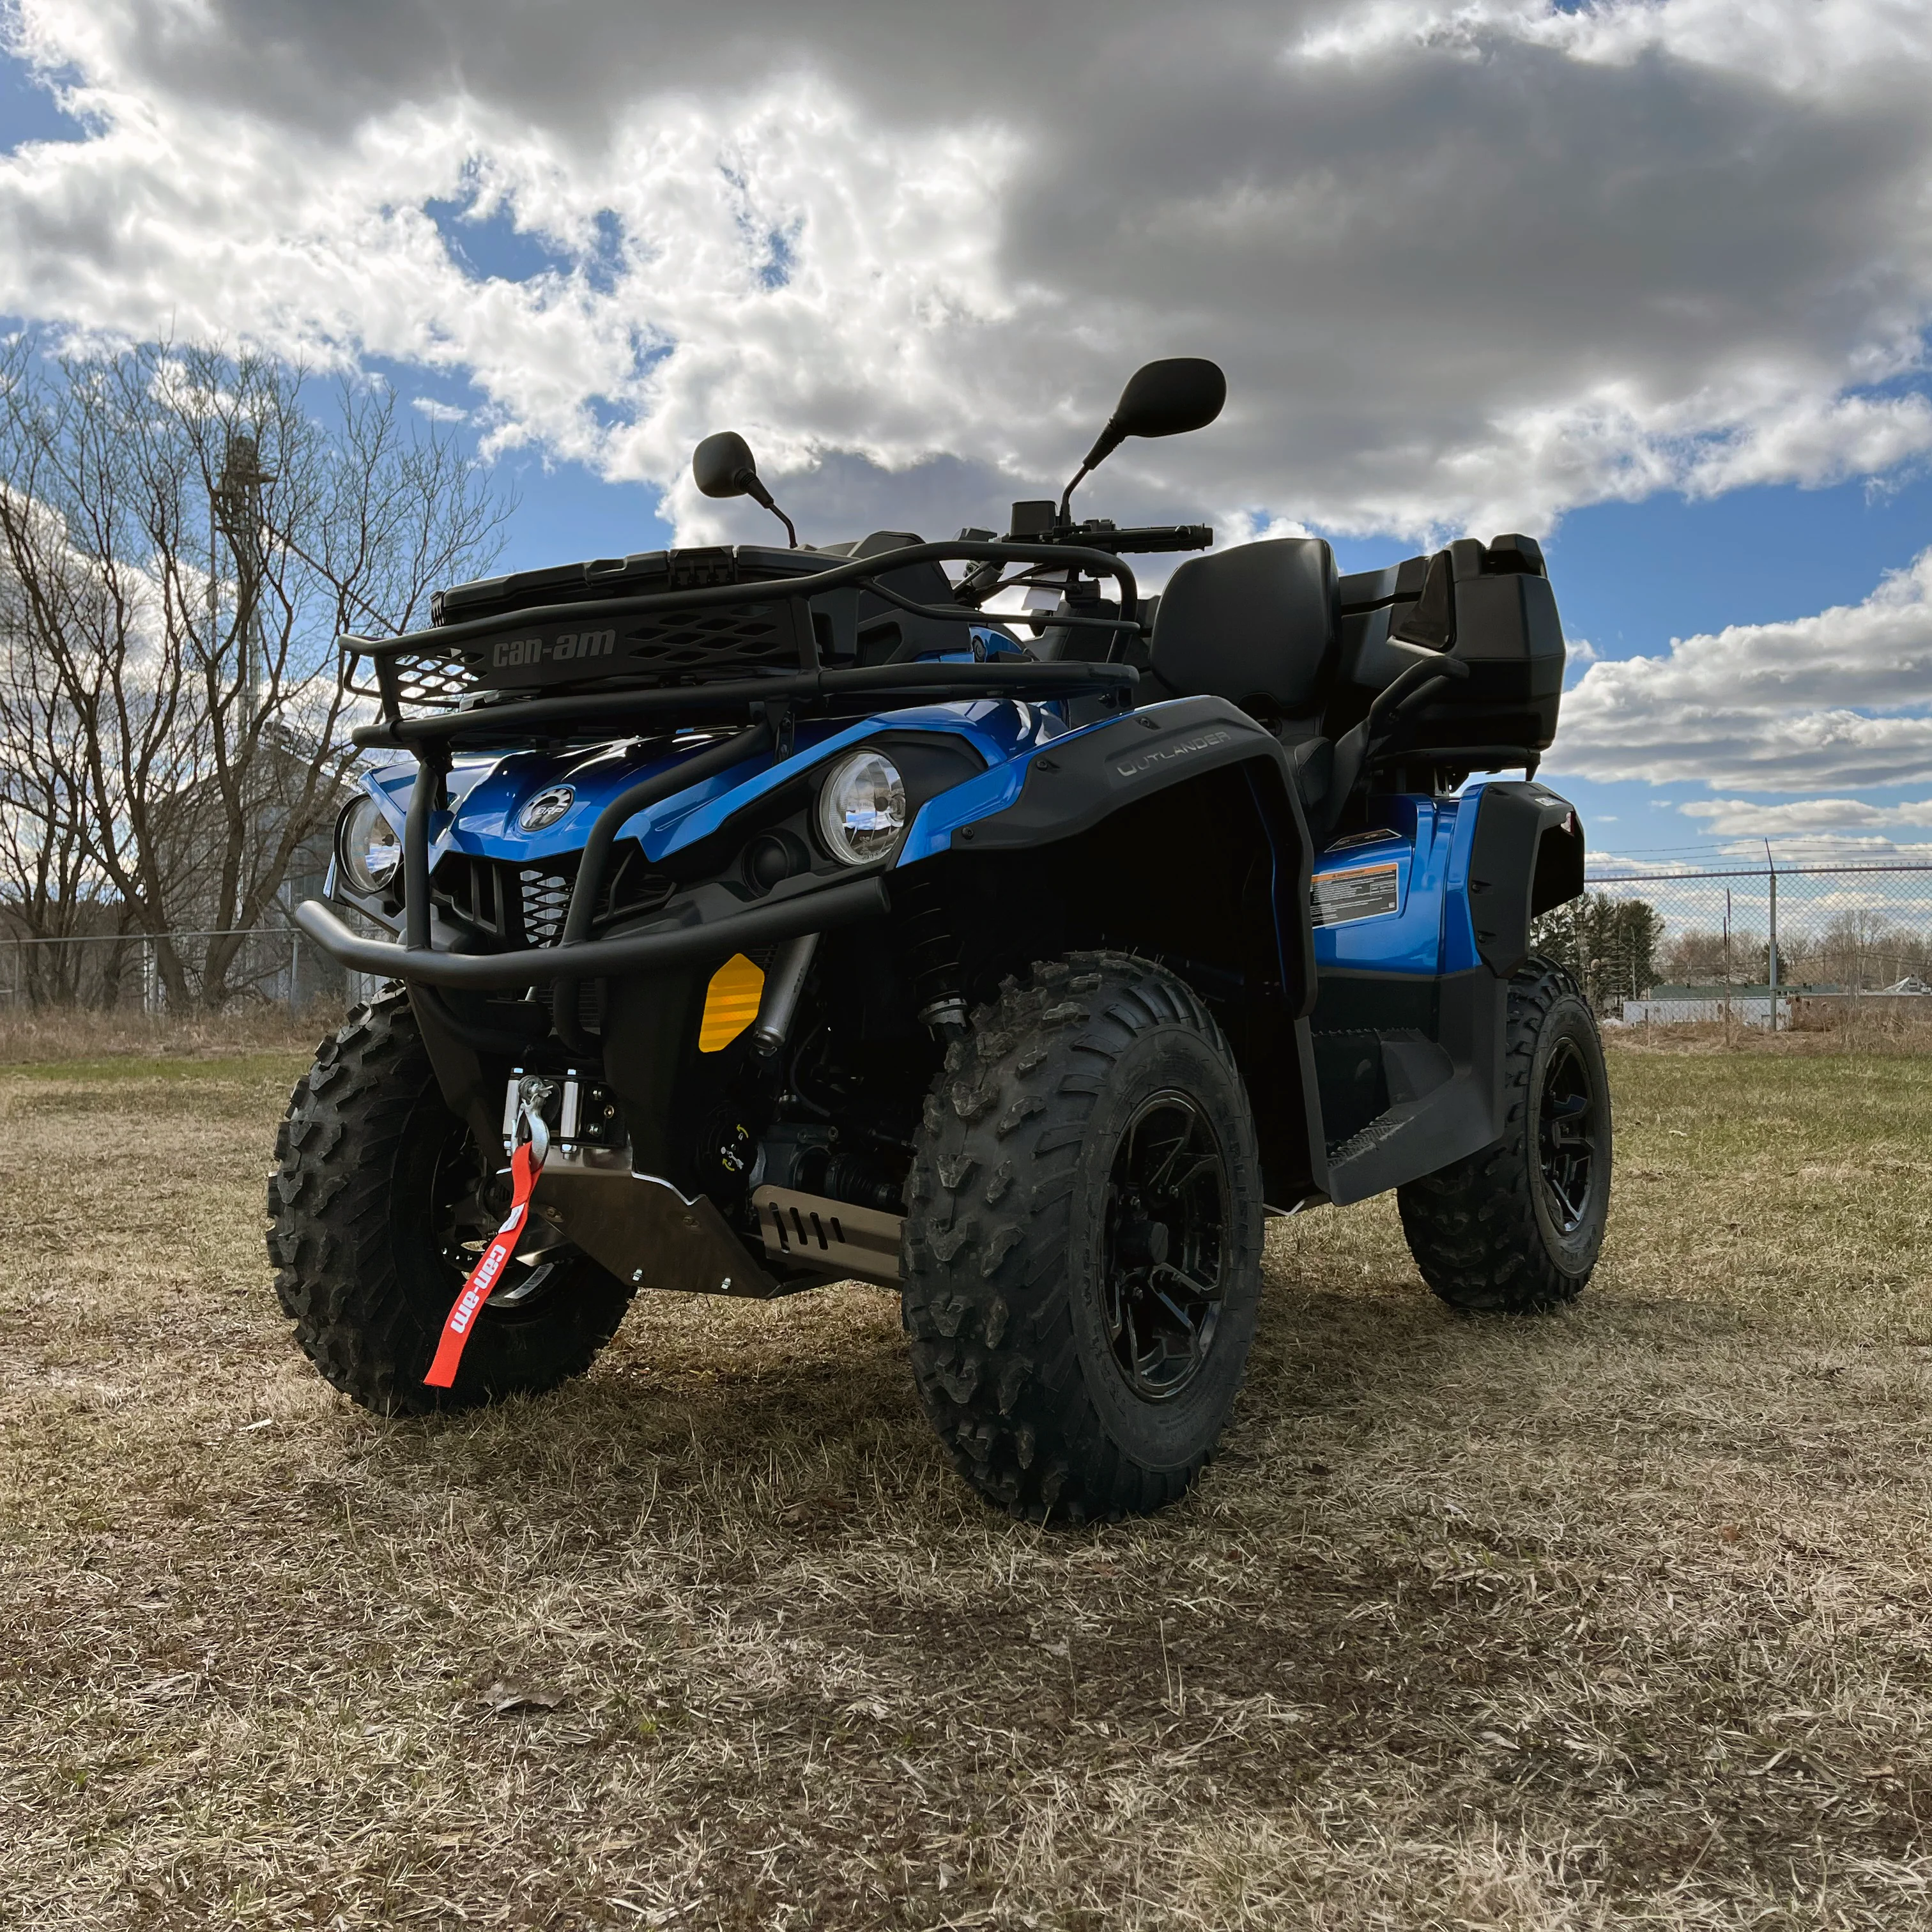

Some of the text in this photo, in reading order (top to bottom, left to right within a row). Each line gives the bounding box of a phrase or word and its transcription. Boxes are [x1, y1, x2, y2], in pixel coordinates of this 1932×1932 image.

[493, 628, 617, 668] can-am
[1116, 731, 1232, 777] OUTLANDER
[535, 806, 565, 816] BRP
[450, 1245, 507, 1334] can-am
